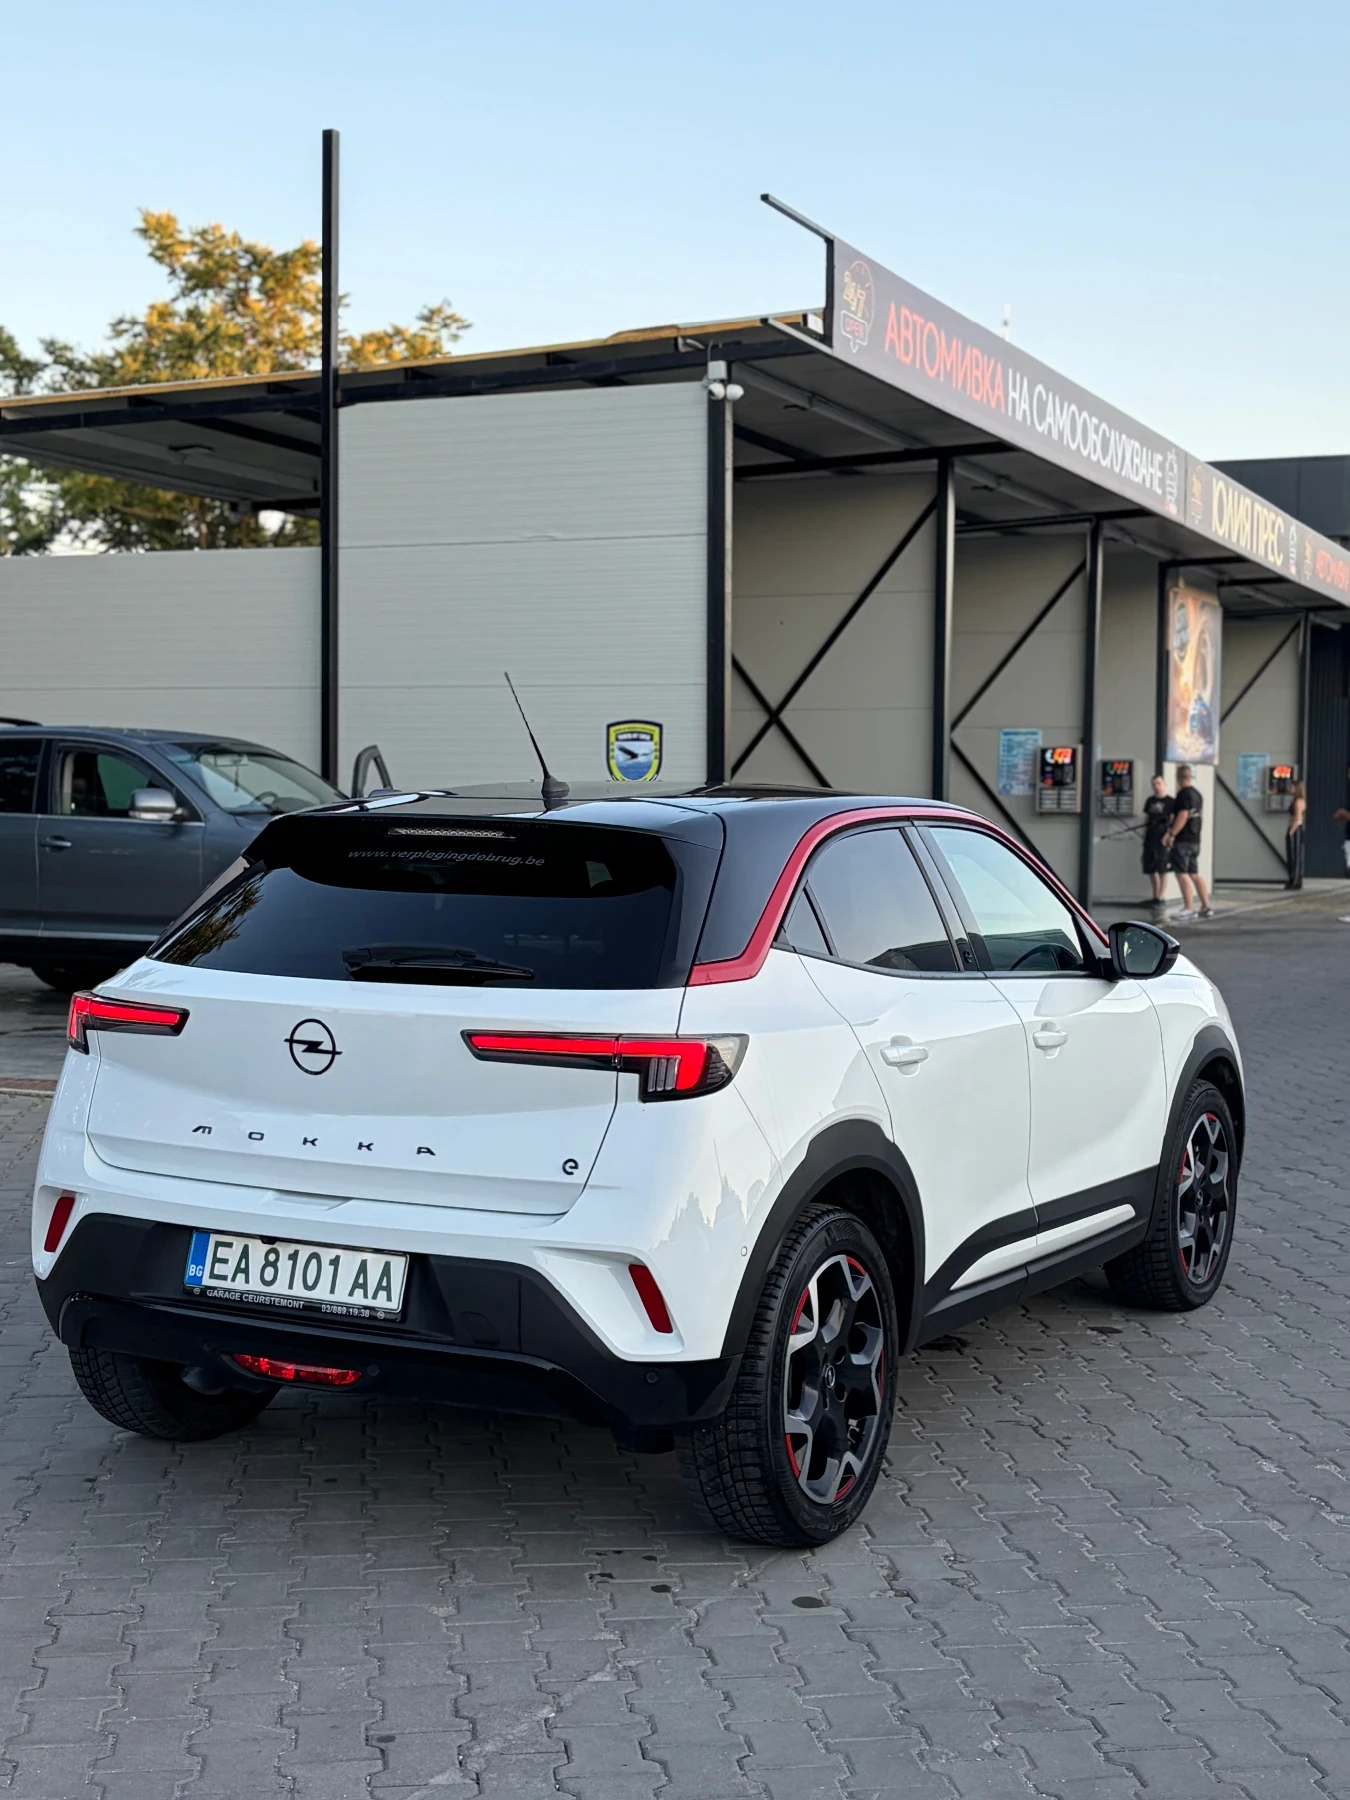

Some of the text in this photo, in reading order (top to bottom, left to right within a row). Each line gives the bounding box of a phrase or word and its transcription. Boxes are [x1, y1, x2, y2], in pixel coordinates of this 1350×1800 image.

[884, 300, 1163, 495] АВТОМИВКА НА САМООБСЛУЖВАНЕ
[1212, 476, 1251, 551] ЮЛИЯ
[1251, 500, 1284, 567] ПРЕС
[192, 1124, 437, 1157] MOKKA
[188, 1263, 203, 1278] BG
[259, 1247, 341, 1295] 8101
[206, 1288, 241, 1301] GARAGE
[242, 1293, 305, 1310] CEURSTEMONT
